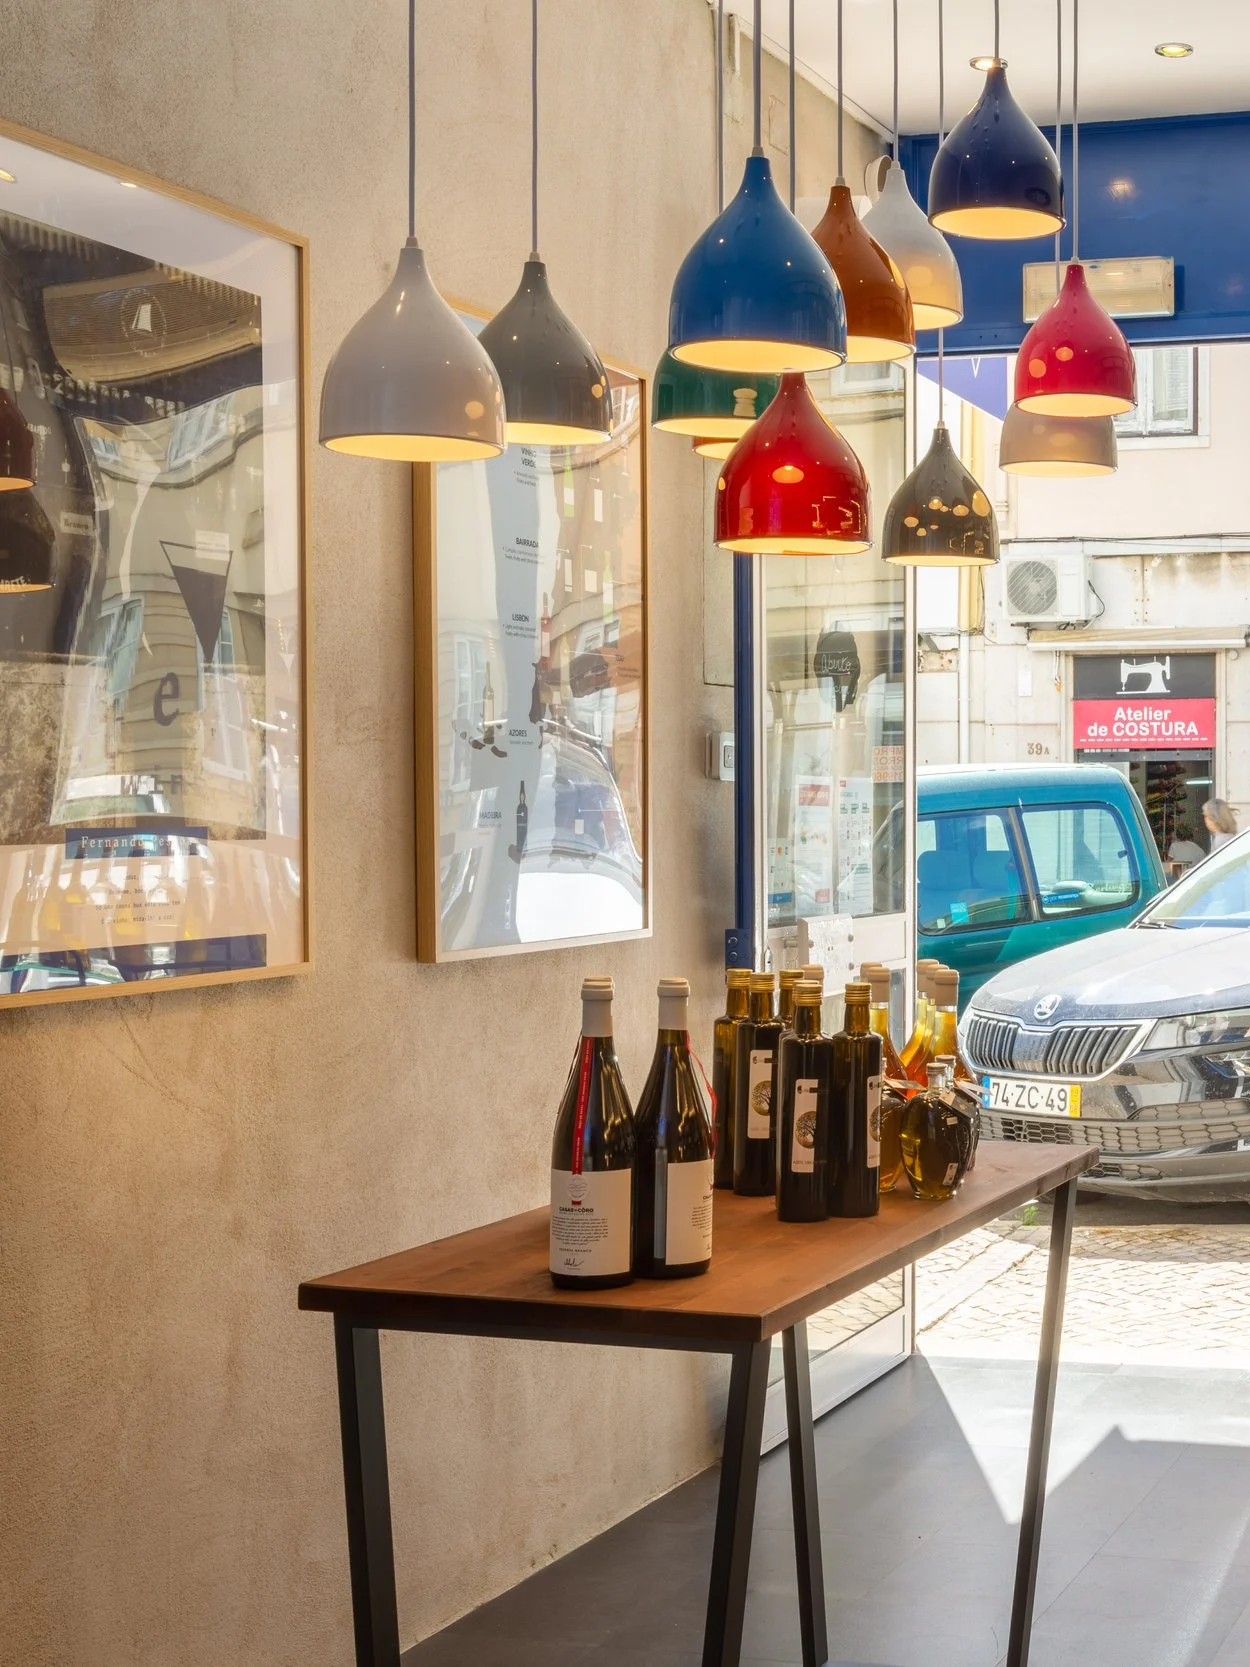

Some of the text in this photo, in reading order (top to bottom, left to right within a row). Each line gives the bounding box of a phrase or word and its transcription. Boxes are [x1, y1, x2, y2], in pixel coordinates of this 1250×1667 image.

[1114, 706, 1172, 721] Atelier
[508, 729, 528, 738] AZORES
[1087, 721, 1199, 737] de COSTURA
[1027, 742, 1050, 755] 39A
[81, 835, 144, 849] Fernando
